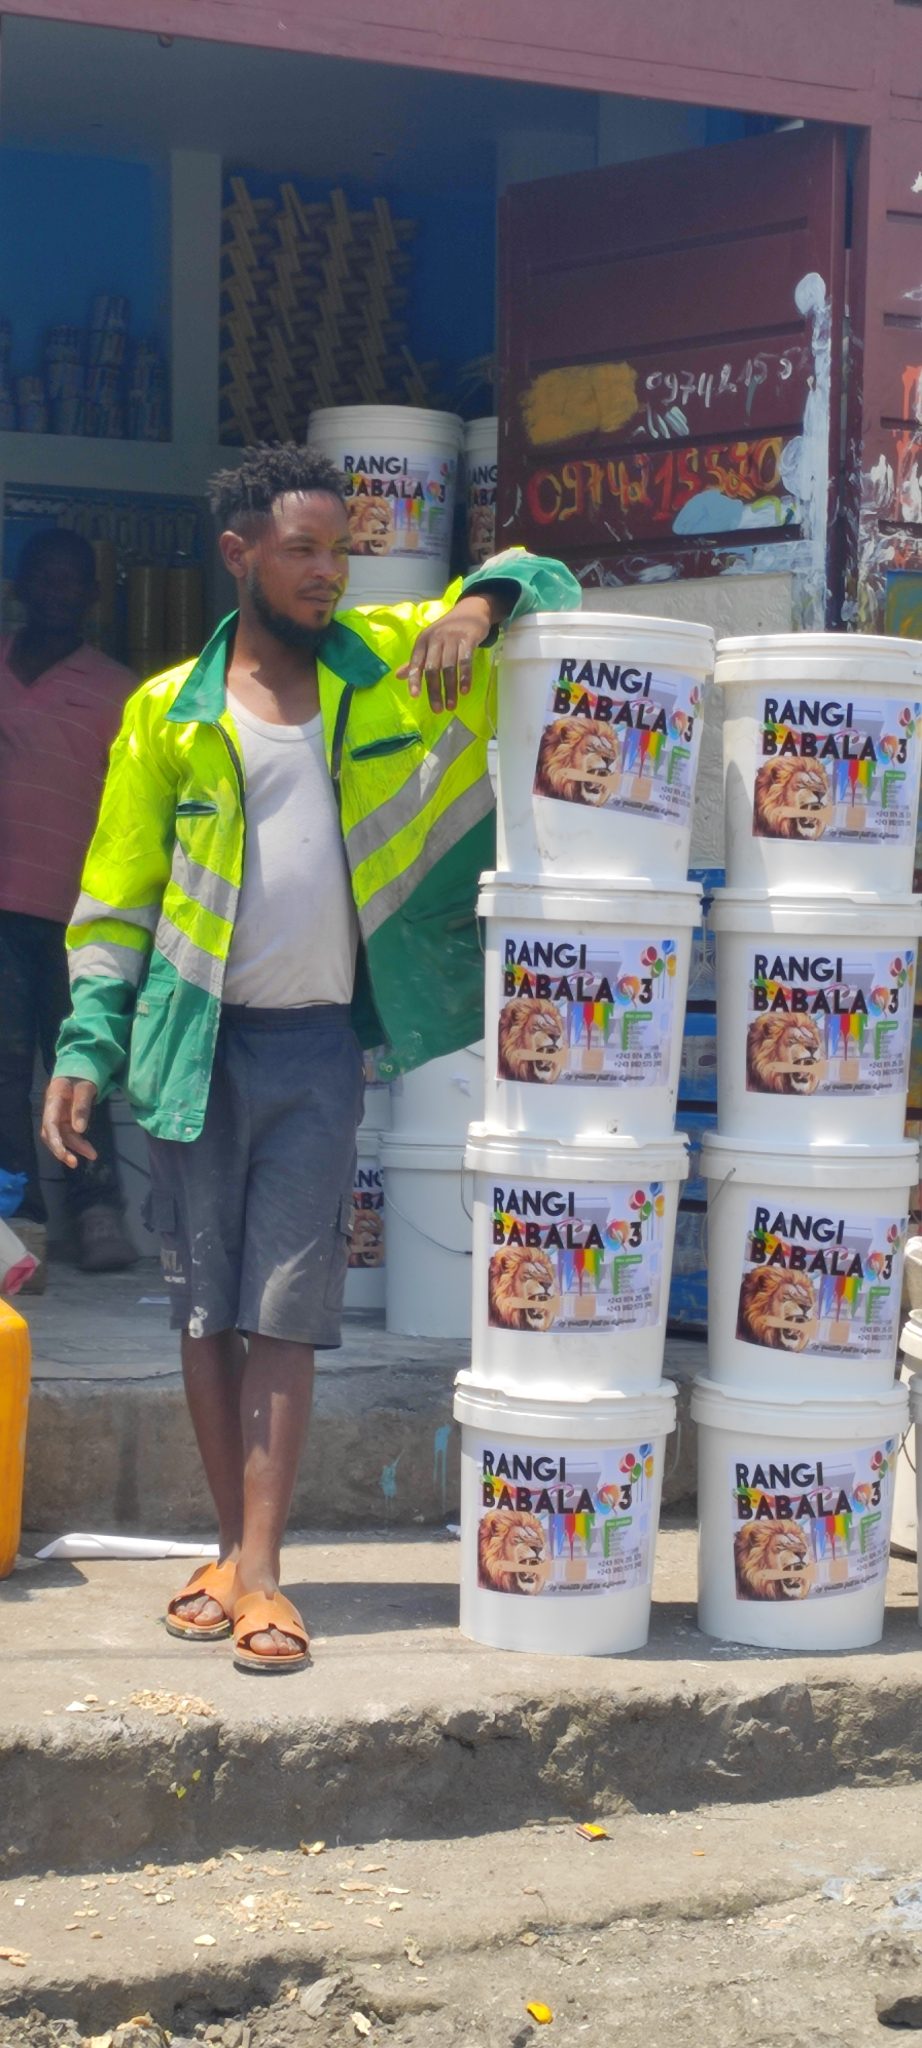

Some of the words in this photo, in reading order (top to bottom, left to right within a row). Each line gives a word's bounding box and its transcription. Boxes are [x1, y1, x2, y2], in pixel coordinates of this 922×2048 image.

[344, 455, 408, 476] RANGI
[559, 658, 653, 697] RANGI
[553, 687, 668, 736] BABALA
[684, 716, 694, 742] 3
[764, 698, 853, 728] RANGI
[762, 730, 877, 761] BABALA
[897, 738, 907, 764] 3
[505, 939, 586, 970] RANGI
[754, 954, 843, 982] RANGI
[504, 971, 615, 1003] BABALA
[639, 978, 653, 1004] 3
[753, 985, 869, 1015] BABALA
[888, 988, 899, 1014] 3
[493, 1187, 575, 1217] RANGI
[493, 1219, 605, 1250] BABALA
[629, 1222, 642, 1248] 3
[754, 1206, 845, 1244] RANGI
[751, 1238, 864, 1278] BABALA
[883, 1255, 893, 1280] 3
[483, 1450, 566, 1482] RANGI
[735, 1461, 824, 1489] RANGI
[483, 1482, 596, 1514] BABALA
[618, 1484, 632, 1510] 3
[737, 1490, 852, 1520] BABALA
[871, 1480, 881, 1506] 3
